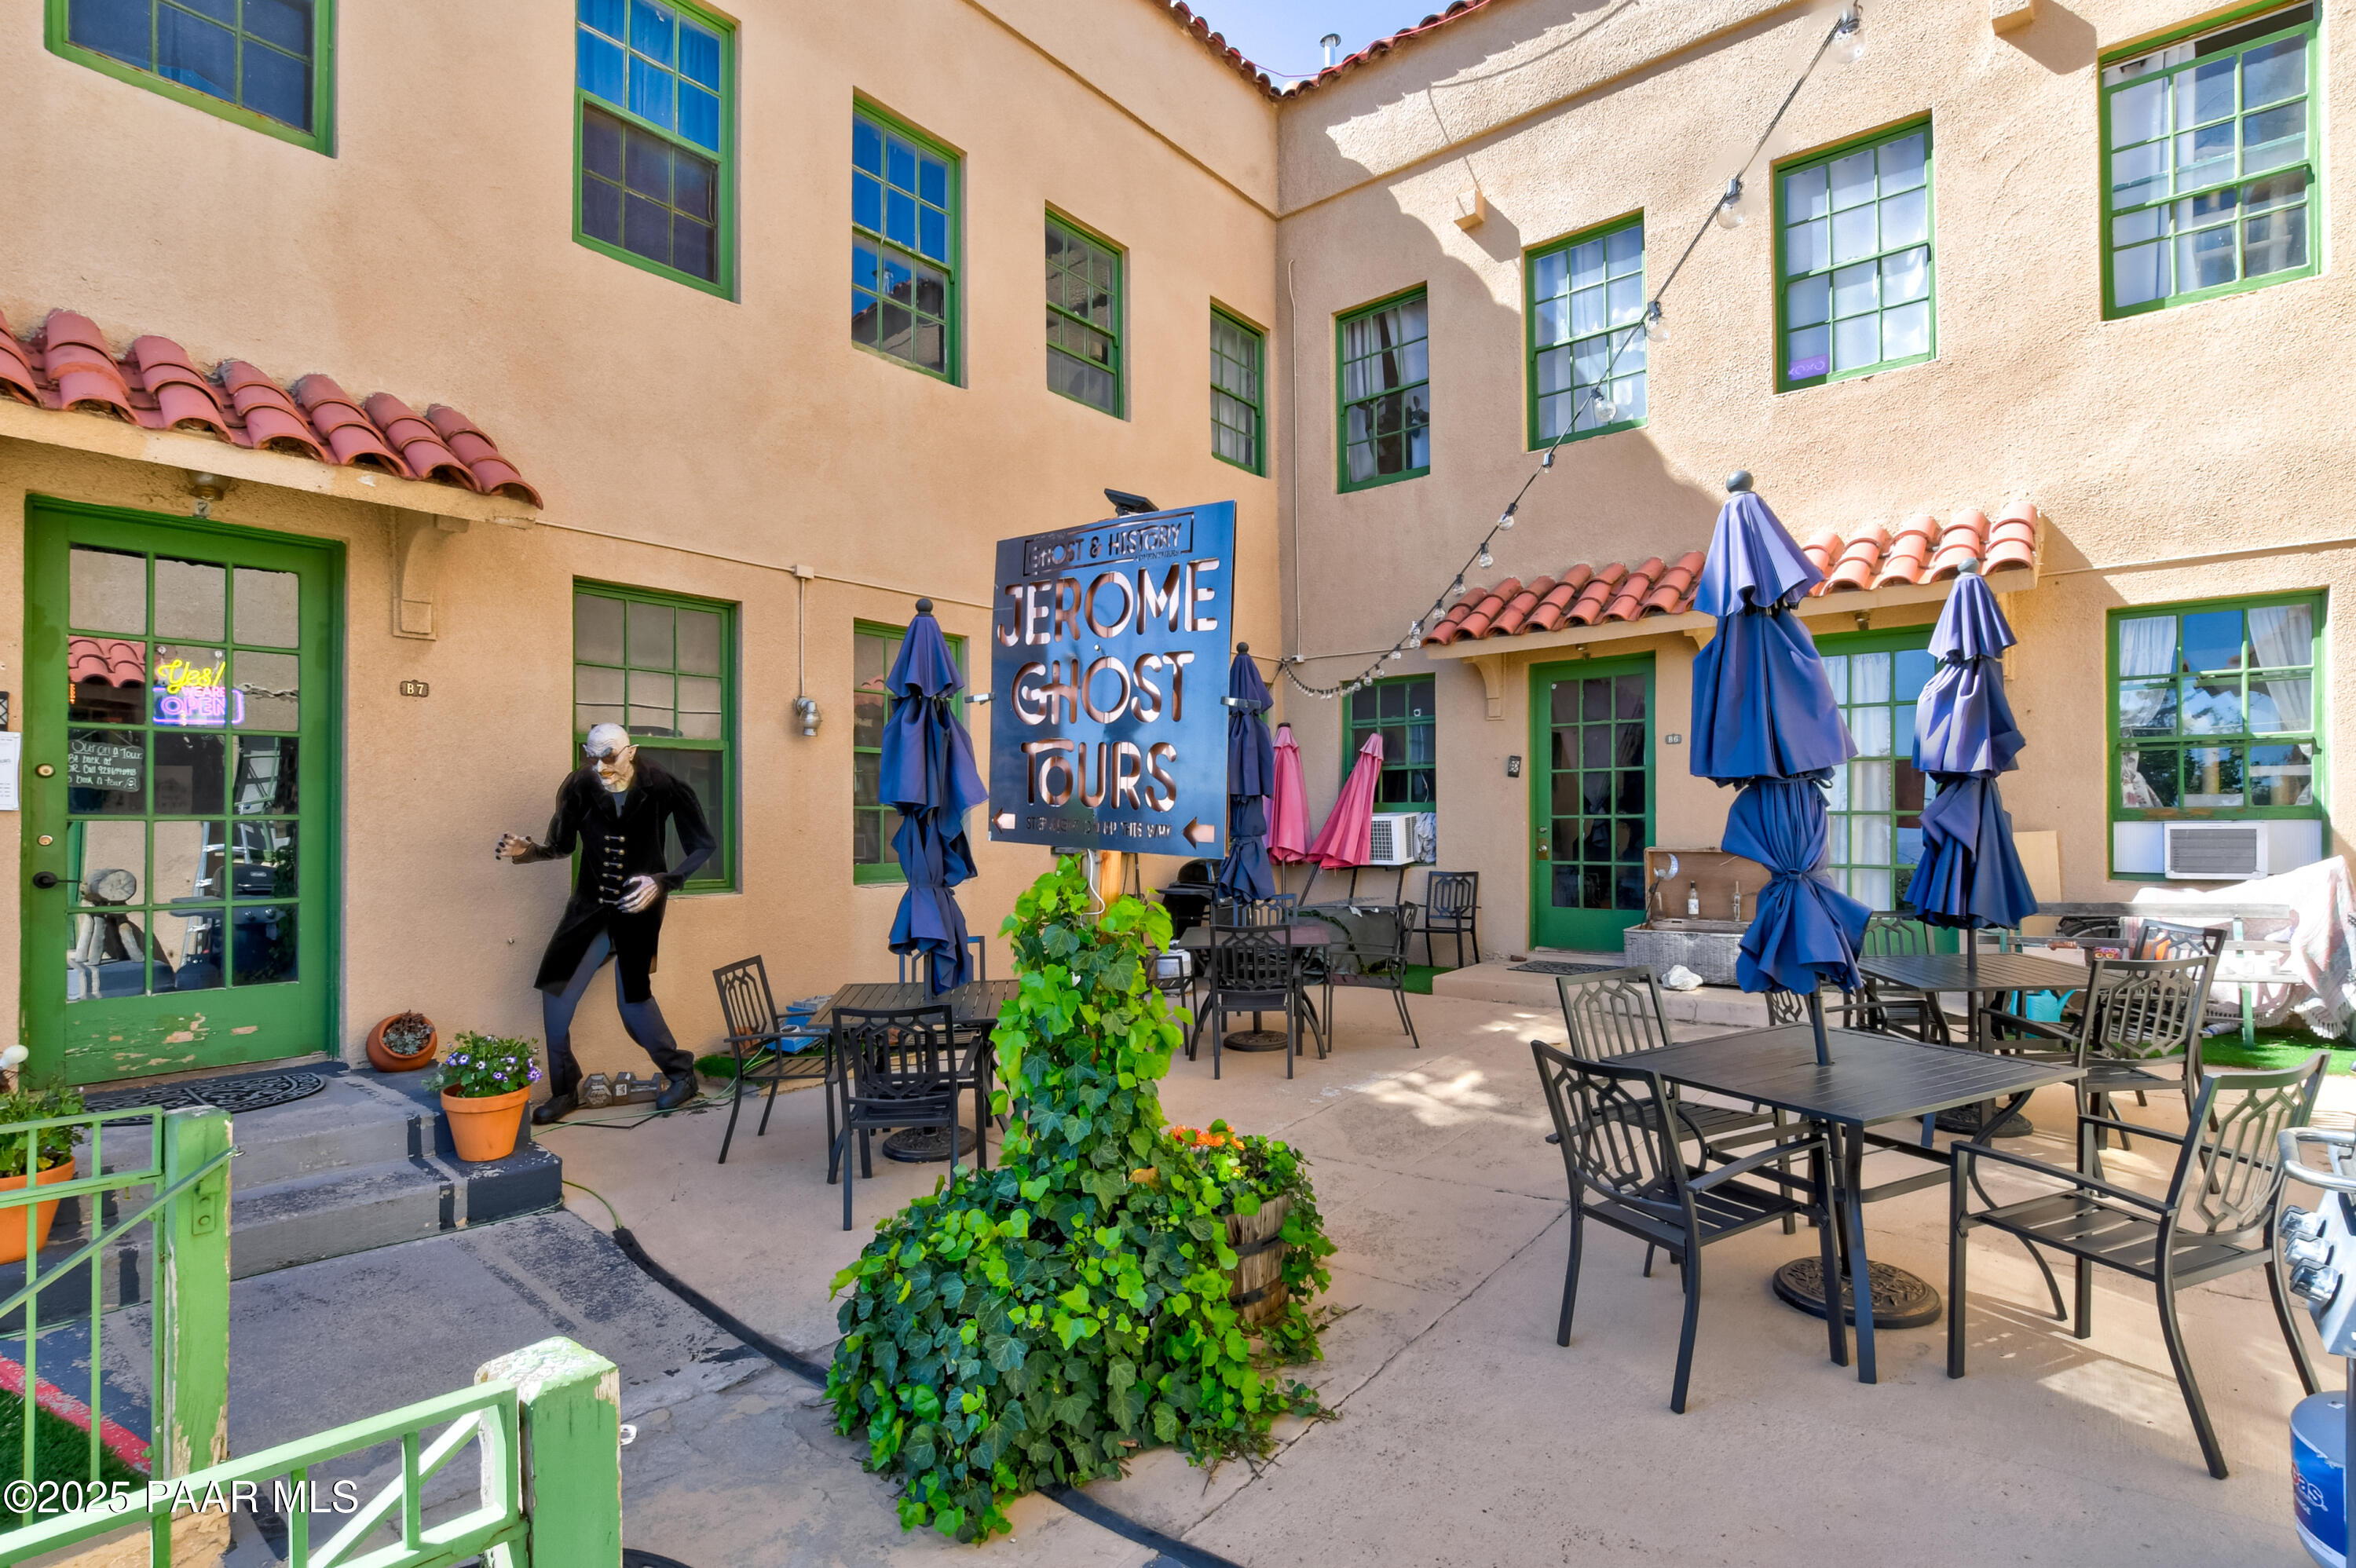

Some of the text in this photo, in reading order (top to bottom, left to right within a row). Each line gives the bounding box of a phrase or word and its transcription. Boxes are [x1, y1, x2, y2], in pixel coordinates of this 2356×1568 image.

[1089, 536, 1102, 558] &
[1108, 523, 1181, 555] HISTORY
[997, 557, 1220, 647] JEROME
[160, 696, 226, 717] OPEN
[1011, 650, 1195, 726] GHOST
[1020, 737, 1177, 813] TOURS
[1103, 821, 1118, 836] UP
[1121, 821, 1143, 838] THIS
[1147, 824, 1173, 839] WAY
